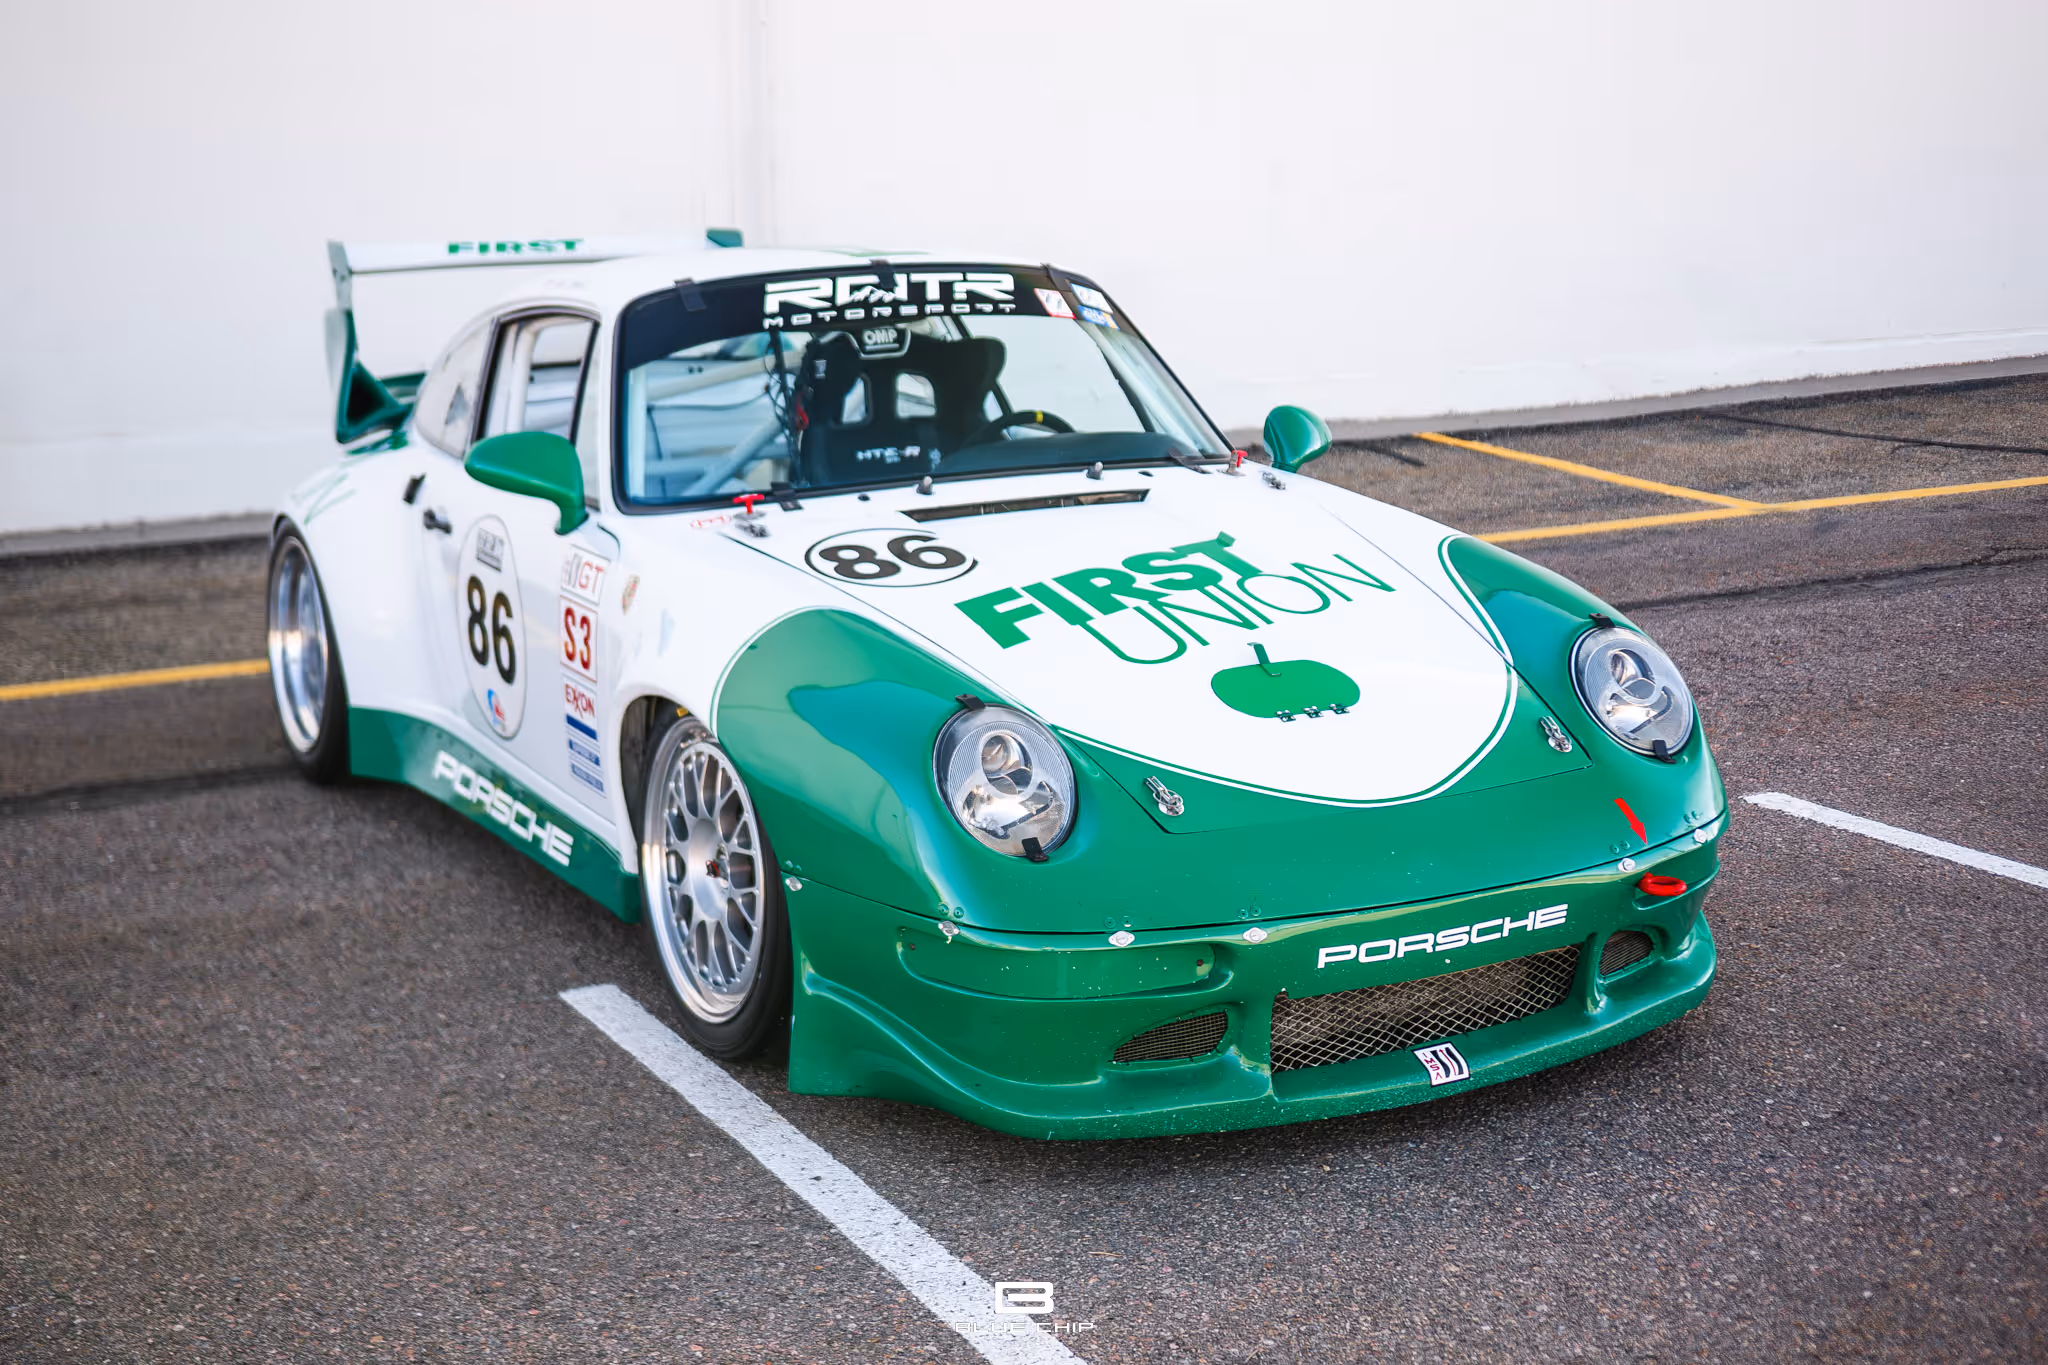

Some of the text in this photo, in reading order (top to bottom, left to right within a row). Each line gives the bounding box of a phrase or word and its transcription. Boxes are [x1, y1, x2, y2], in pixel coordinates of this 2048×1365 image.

[448, 239, 583, 254] FIRST
[762, 303, 1016, 330] MOTORSPORT
[863, 328, 899, 345] OMP
[578, 561, 605, 594] GT
[818, 535, 967, 580] 86
[955, 531, 1263, 649] FIRST
[1079, 554, 1396, 665] UNION
[467, 575, 516, 685] 86
[564, 607, 591, 670] S3
[565, 684, 596, 719] EXXON
[432, 751, 574, 867] PORSCHE
[1317, 904, 1568, 969] PORSCHE
[1422, 1052, 1443, 1080] IMSA
